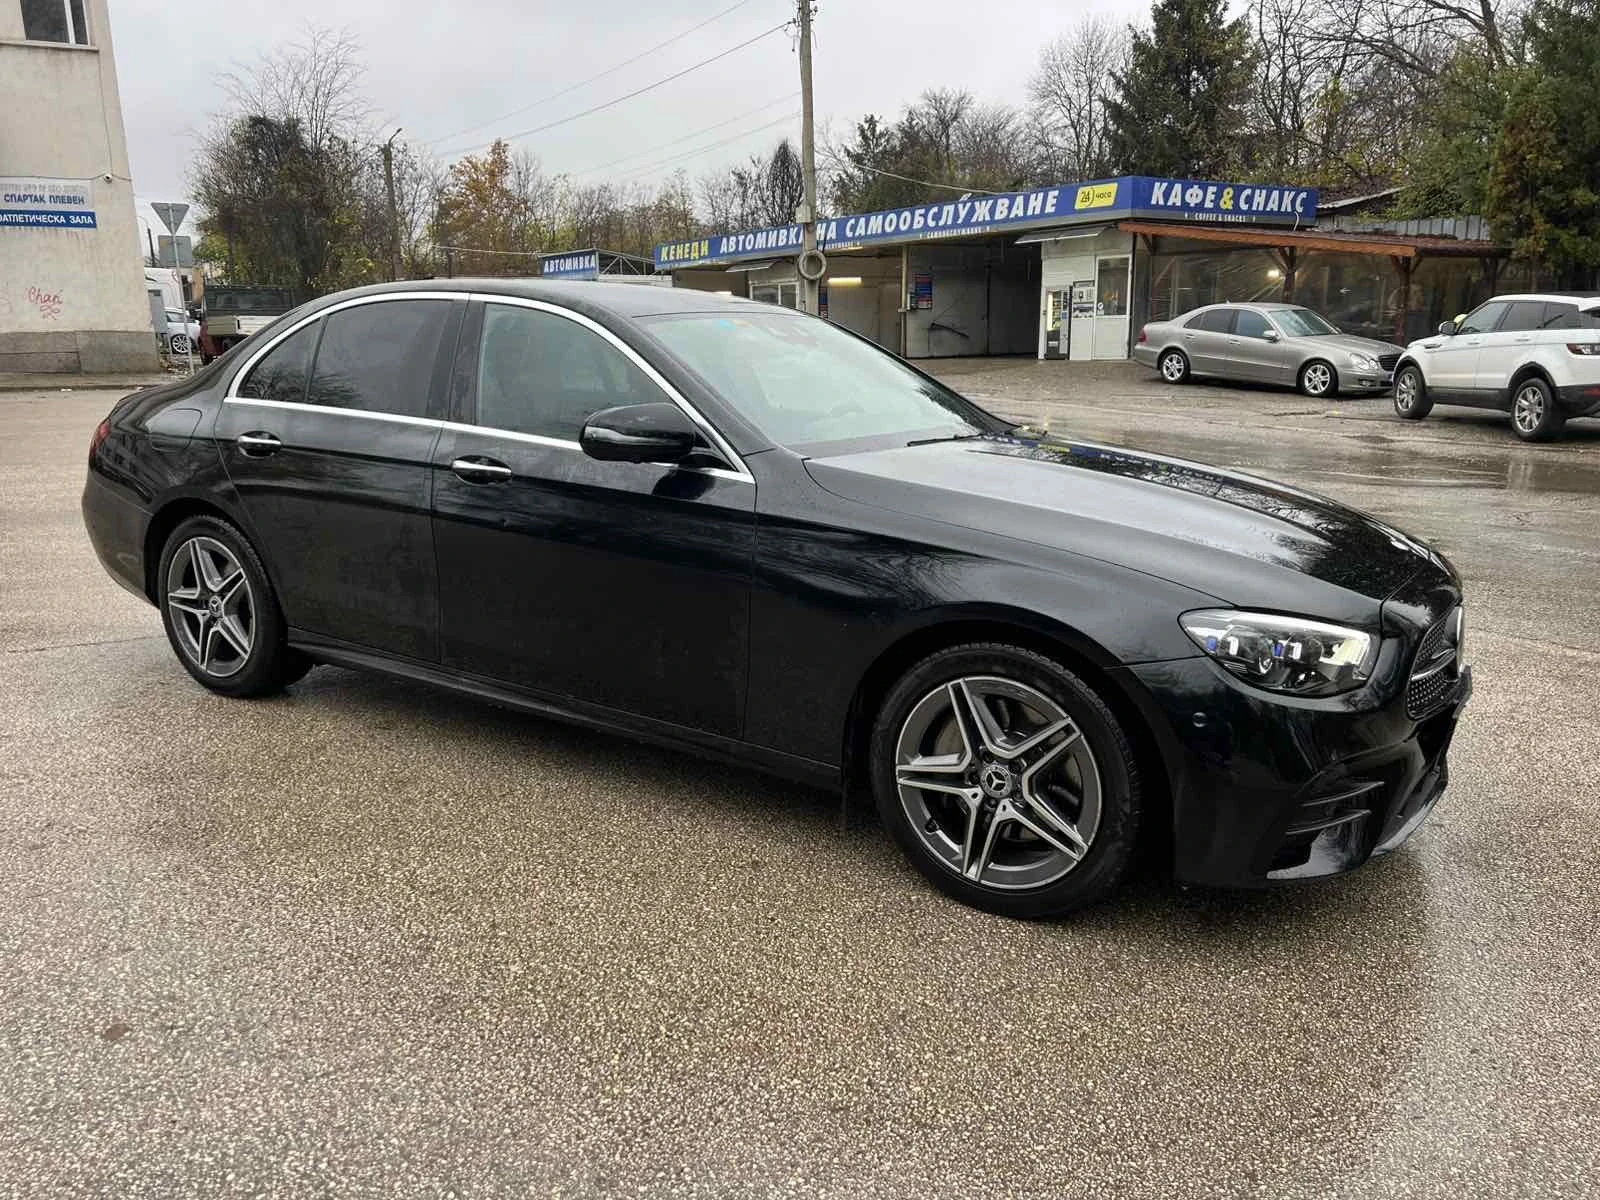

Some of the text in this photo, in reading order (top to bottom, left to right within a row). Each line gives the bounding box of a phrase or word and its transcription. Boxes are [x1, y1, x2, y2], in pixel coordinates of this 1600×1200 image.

[4, 194, 85, 205] СПАРТАК ПЛЕВЕН
[1151, 182, 1307, 213] КАФЕ & СНАКС
[69, 215, 93, 224] ЗАЛА
[661, 240, 709, 262] КЕНЕДИ
[816, 221, 837, 241] НА
[544, 254, 596, 272] АВТОМИВКА
